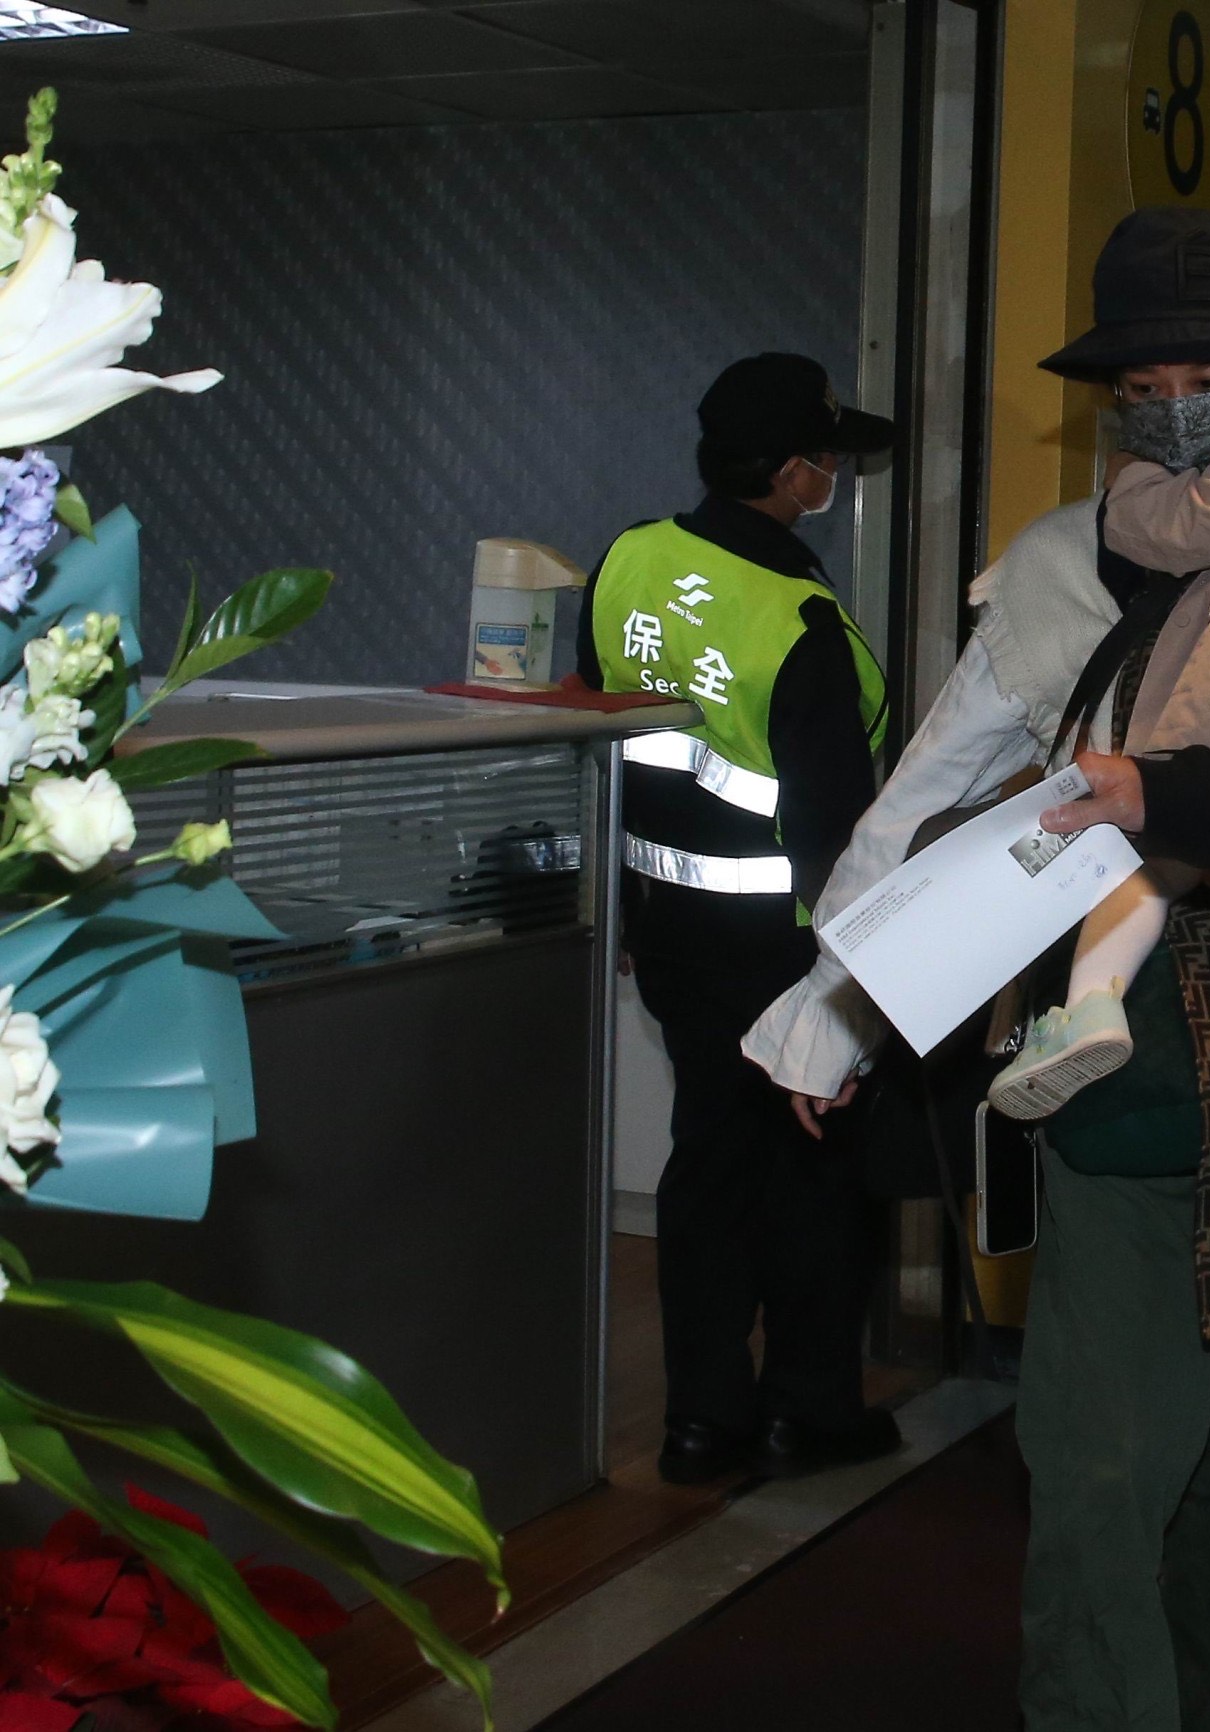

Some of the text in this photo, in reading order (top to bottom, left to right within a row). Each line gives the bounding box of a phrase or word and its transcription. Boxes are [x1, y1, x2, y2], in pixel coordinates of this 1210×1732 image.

[1164, 10, 1204, 197] 8
[623, 608, 735, 706] 保全
[664, 599, 704, 627] Metro Taipei
